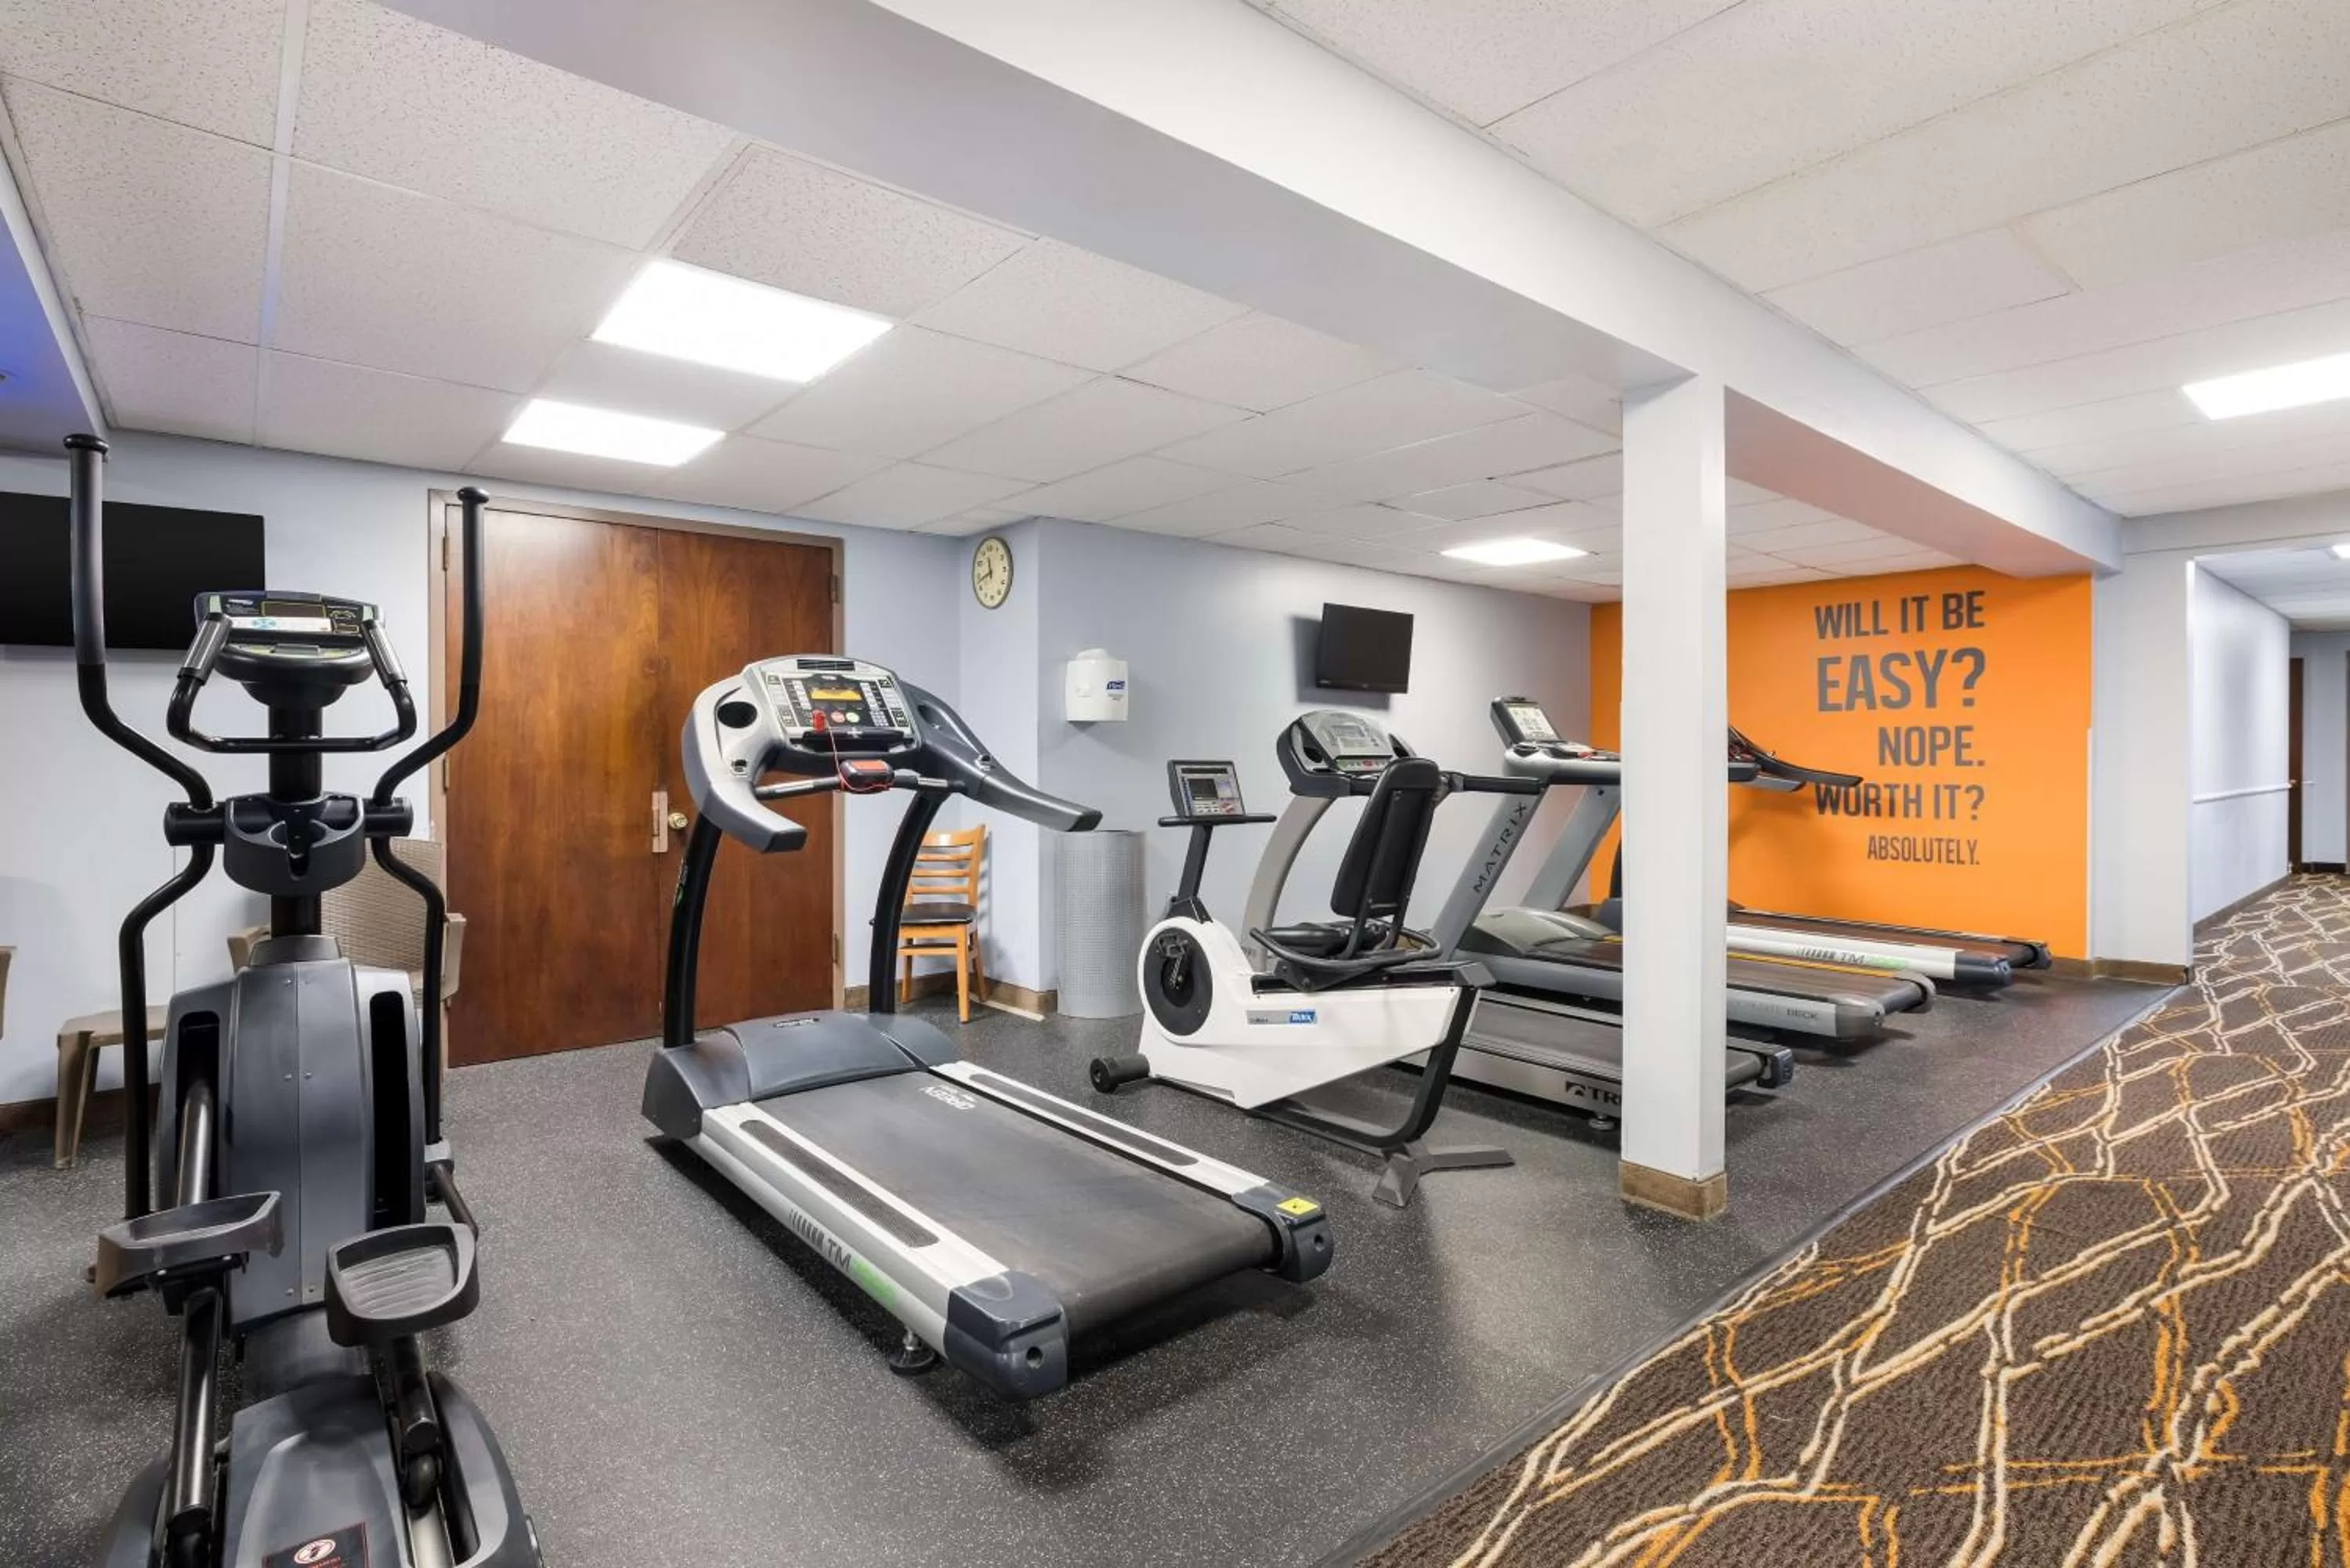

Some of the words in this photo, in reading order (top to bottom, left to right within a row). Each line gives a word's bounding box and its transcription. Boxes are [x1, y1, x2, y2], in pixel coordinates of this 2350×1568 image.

[1814, 600, 1889, 639] WILL
[1900, 595, 1930, 633] IT
[1942, 590, 1986, 630] BE
[1817, 647, 1986, 712] EASY?
[1878, 725, 1986, 767] NOPE.
[1814, 782, 1922, 818] WORTH
[1933, 784, 1985, 821] IT?
[1473, 801, 1527, 893] MATRIX
[1867, 834, 1980, 865] ABSOLUTELY.
[1588, 1086, 1622, 1106] TR
